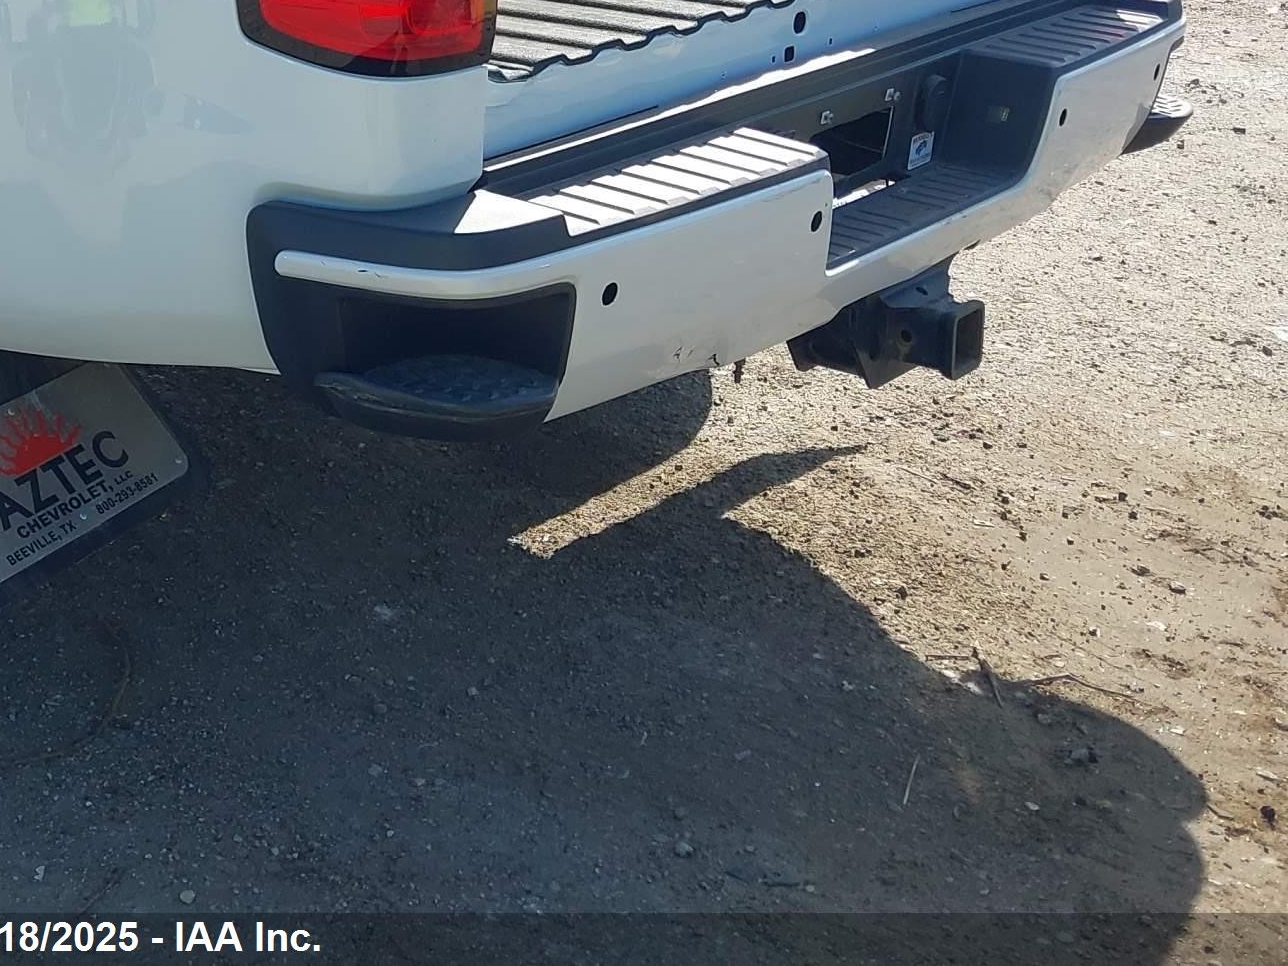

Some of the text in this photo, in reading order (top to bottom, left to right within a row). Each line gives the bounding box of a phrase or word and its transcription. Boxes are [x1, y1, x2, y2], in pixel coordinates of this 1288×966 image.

[17, 470, 133, 539] CHEVROLET, LLC
[6, 531, 62, 566] BEEVILLE,
[61, 520, 77, 535] TX
